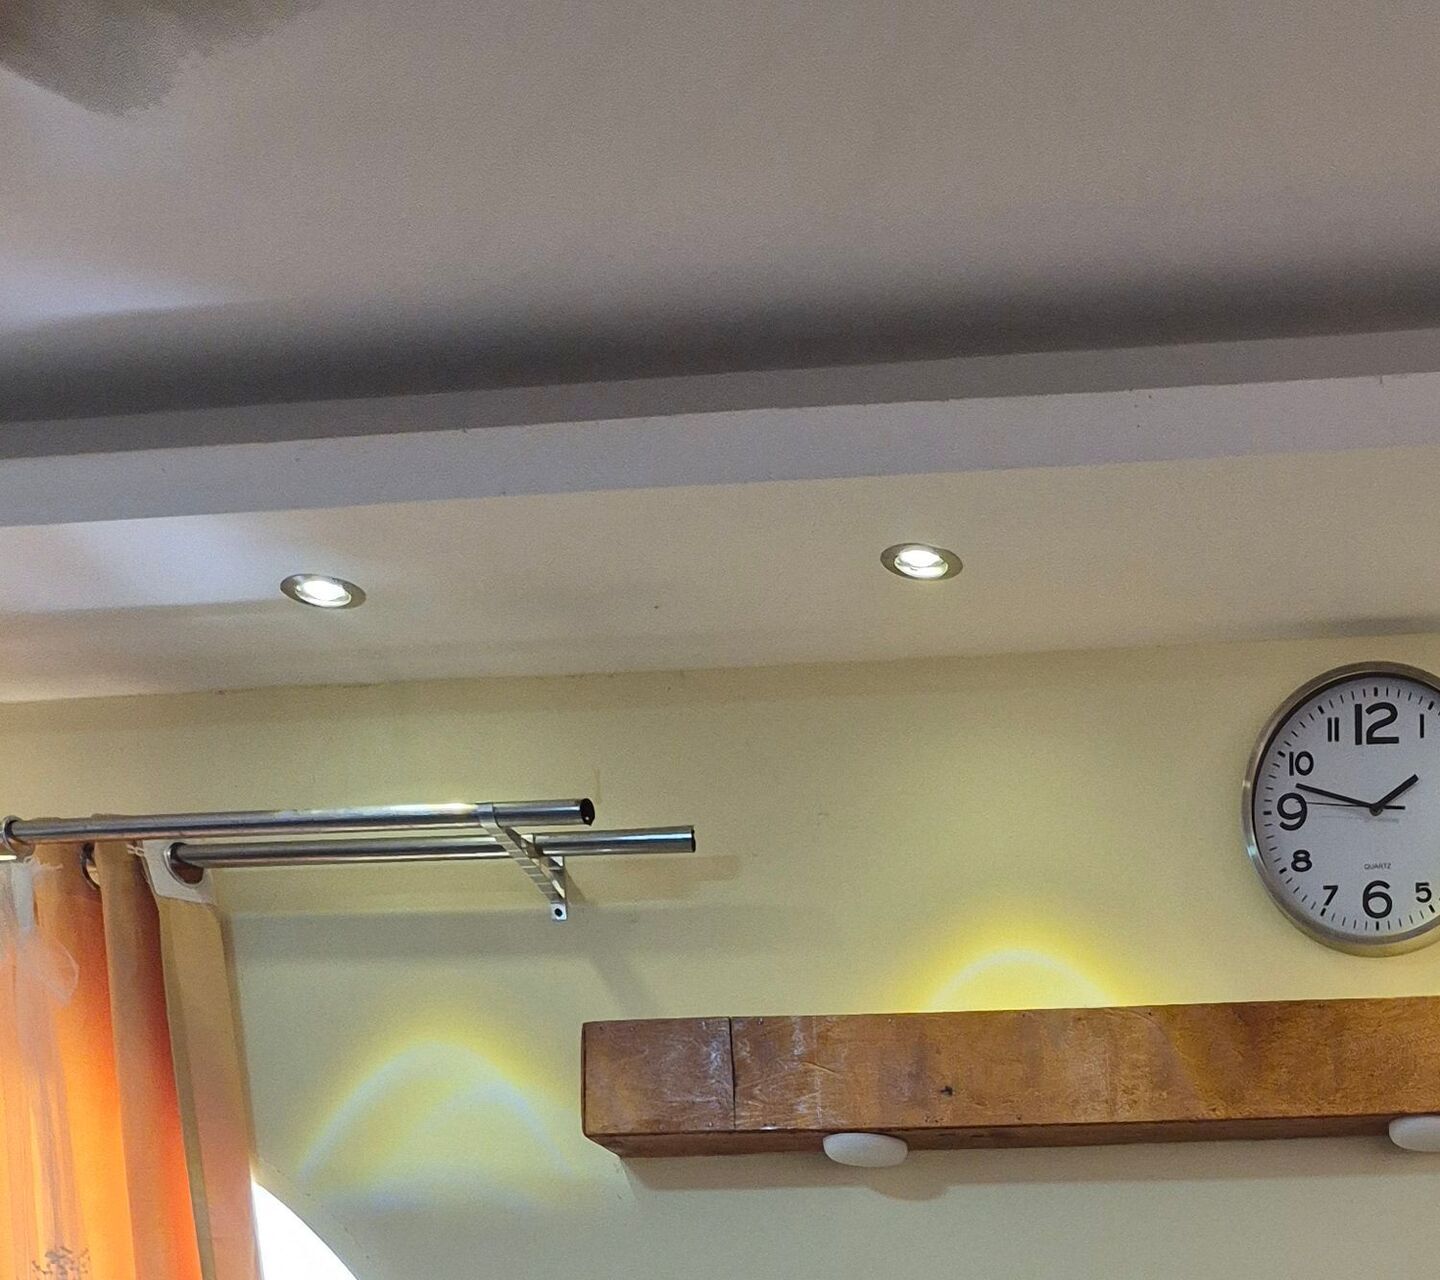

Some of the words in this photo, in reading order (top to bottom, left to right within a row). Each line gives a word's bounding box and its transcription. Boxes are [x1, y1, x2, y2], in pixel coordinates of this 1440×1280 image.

[1327, 717, 1340, 742] 11
[1355, 702, 1399, 745] 12
[1419, 714, 1425, 739] 1
[1288, 751, 1314, 776] 10
[1277, 792, 1308, 831] 9
[1291, 849, 1312, 873] 8
[1363, 862, 1392, 870] QUARTZ
[1322, 885, 1339, 906] 7
[1362, 880, 1393, 919] 6
[1415, 882, 1432, 904] 5
